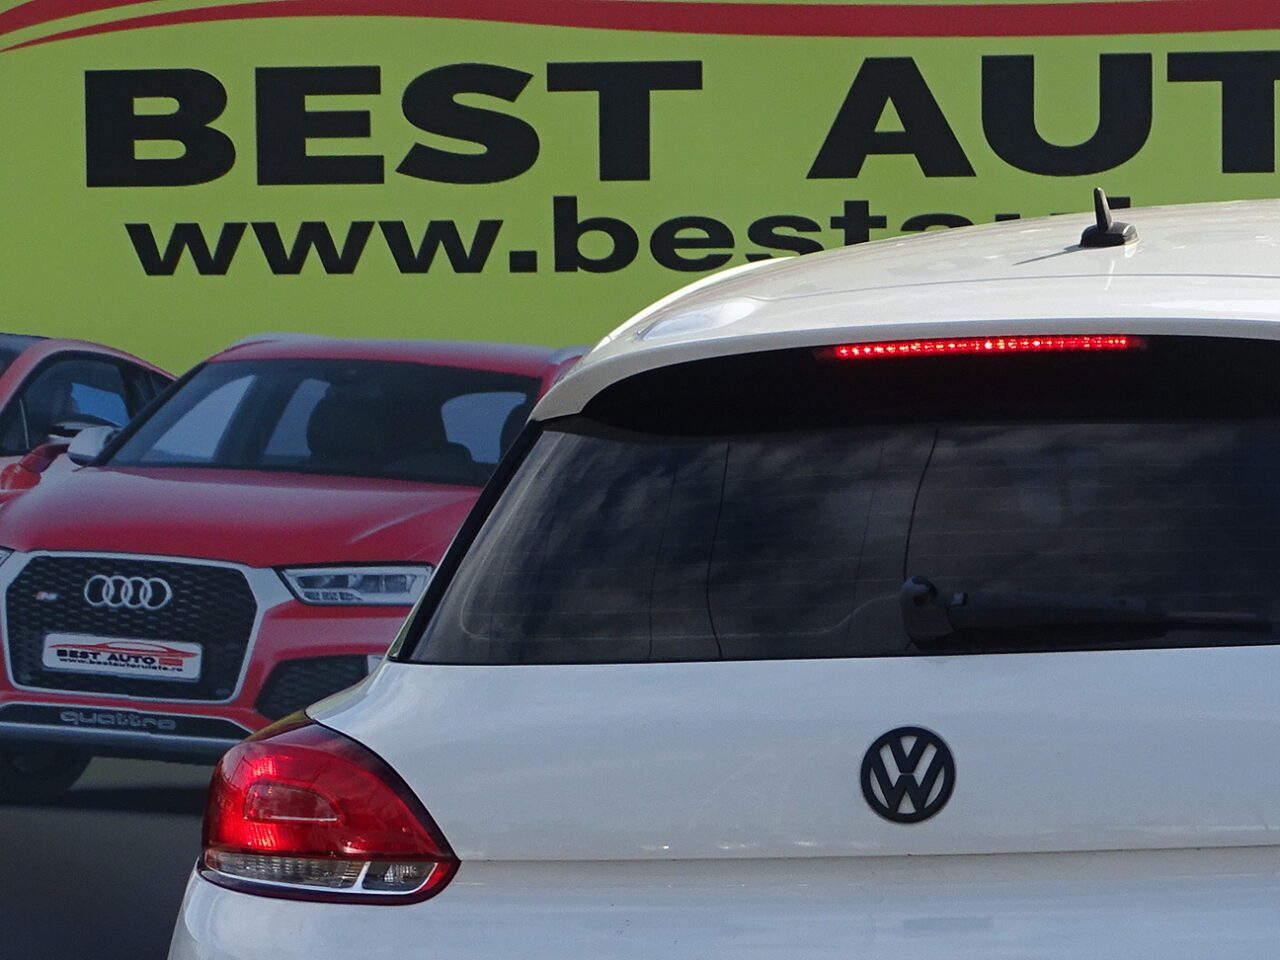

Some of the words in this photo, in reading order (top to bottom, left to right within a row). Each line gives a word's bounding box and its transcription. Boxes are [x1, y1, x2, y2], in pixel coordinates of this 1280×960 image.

[85, 61, 703, 187] BEST
[56, 649, 101, 661] BEST
[107, 653, 155, 665] AUTO
[60, 711, 176, 730] quattro
